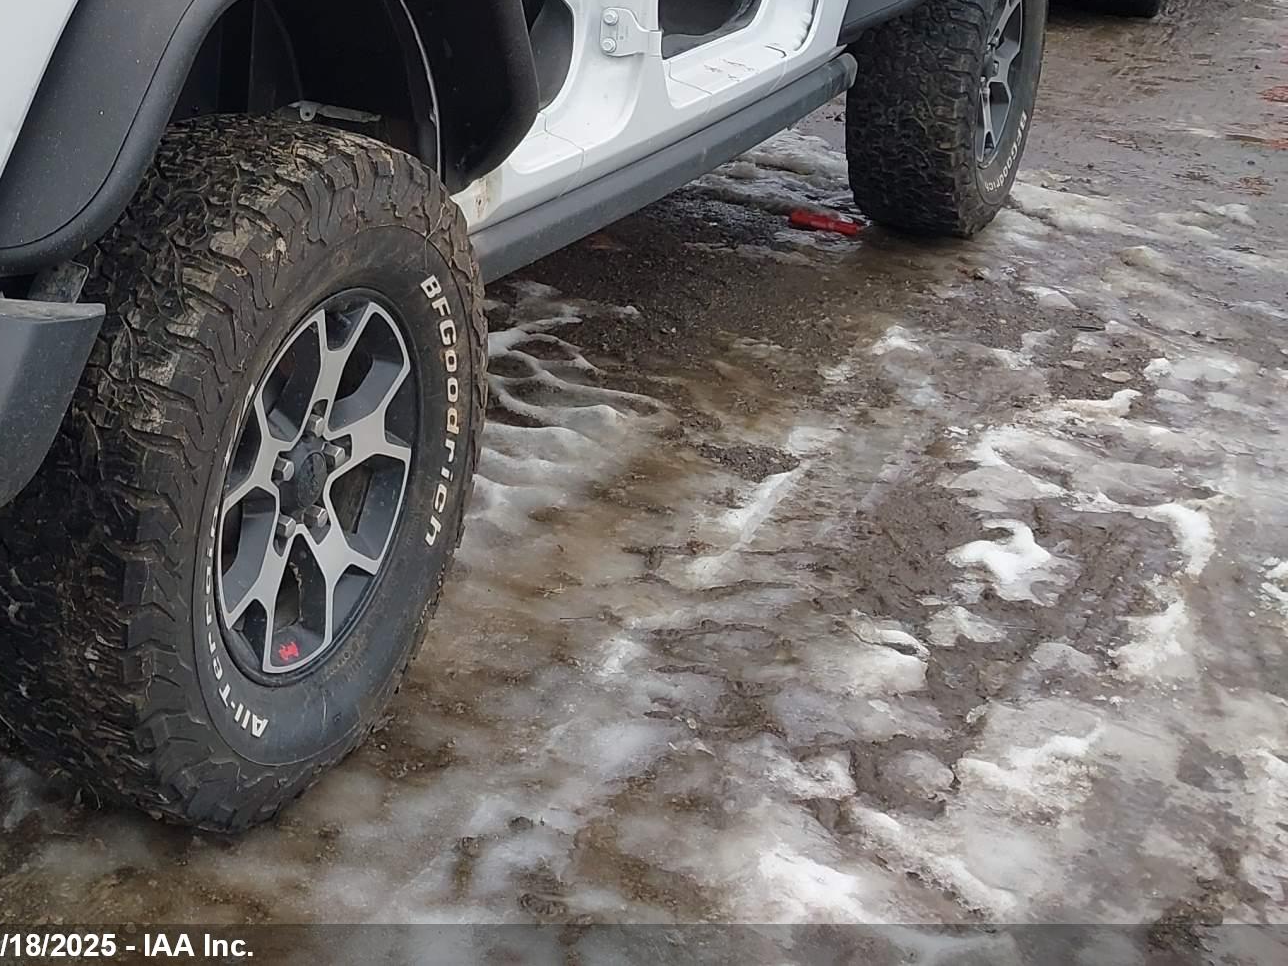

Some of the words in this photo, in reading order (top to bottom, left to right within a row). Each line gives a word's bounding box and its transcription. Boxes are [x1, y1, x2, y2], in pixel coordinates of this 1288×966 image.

[984, 109, 1028, 192] BFGoodrich
[420, 275, 460, 546] BFGoodrich
[206, 505, 268, 737] All-Terrain
